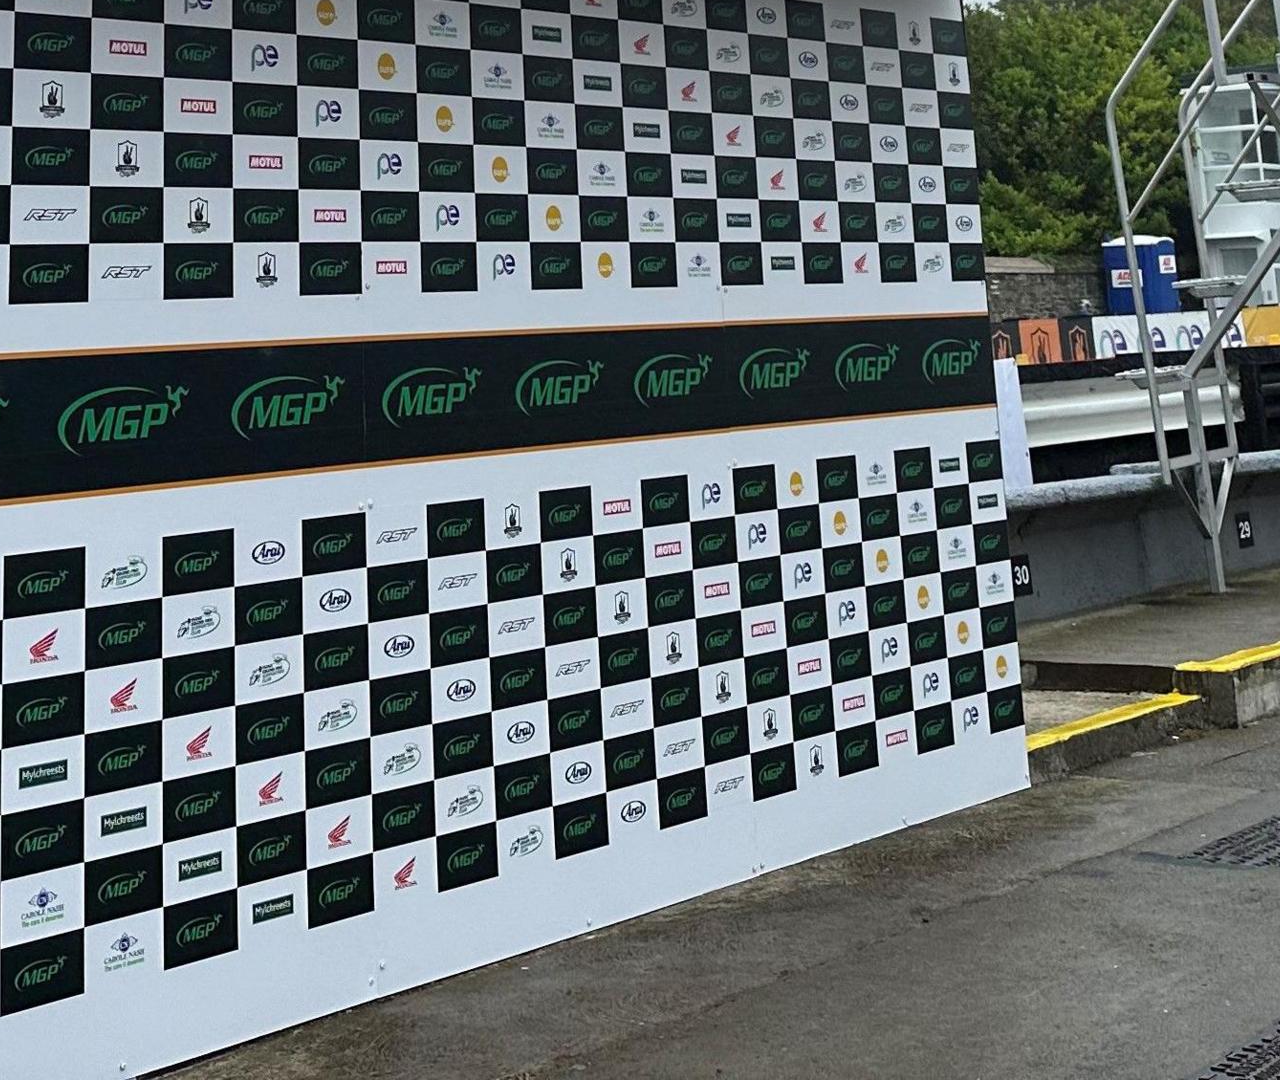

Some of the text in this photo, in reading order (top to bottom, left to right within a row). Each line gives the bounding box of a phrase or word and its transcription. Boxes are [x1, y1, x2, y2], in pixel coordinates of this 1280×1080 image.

[248, 1, 277, 15] MGP
[33, 37, 68, 52] MGP
[110, 41, 146, 54] MOTUL
[181, 47, 211, 62] MGP
[312, 57, 339, 71] MGP
[109, 97, 141, 112] MGP
[181, 100, 215, 112] MOTUL
[248, 104, 278, 118] MGP
[31, 151, 66, 166] MGP
[181, 155, 212, 169] MGP
[313, 159, 341, 172] MGP
[23, 207, 77, 221] RST
[108, 210, 141, 224] MGP
[249, 211, 279, 224] MGP
[29, 269, 65, 283] MGP
[100, 264, 152, 279] RST
[181, 266, 212, 280] MGP
[315, 264, 343, 277] MGP
[845, 356, 891, 383] MGP
[931, 351, 973, 377] MGP
[647, 368, 701, 398] MGP
[750, 362, 801, 390] MGP
[529, 374, 592, 407] MGP
[397, 383, 468, 417] MGP
[249, 391, 328, 429] MGP
[78, 403, 170, 443] MGP
[603, 500, 629, 514] MOTUL
[376, 526, 418, 545] RST
[442, 522, 467, 538] MGP
[1239, 521, 1251, 539] 29
[256, 543, 281, 559] Arai
[318, 538, 347, 555] MGP
[654, 542, 680, 556] MOTUL
[180, 556, 212, 574] MGP
[1013, 564, 1029, 585] 30
[24, 576, 60, 595] MGP
[383, 585, 410, 602] MGP
[251, 605, 282, 623] MGP
[104, 627, 138, 646] MGP
[445, 630, 471, 647] MGP
[320, 651, 349, 670] MGP
[180, 675, 213, 695] MGP
[23, 702, 59, 723] MGP
[385, 696, 413, 714] MGP
[252, 722, 283, 741] MGP
[448, 739, 474, 757] MGP
[104, 751, 138, 772] MGP
[322, 766, 351, 786] MGP
[181, 797, 213, 818] MGP
[388, 809, 416, 828] MGP
[22, 831, 59, 854] MGP
[254, 841, 285, 862] MGP
[452, 849, 479, 869] MGP
[104, 877, 139, 900] MGP
[324, 883, 354, 904] MGP
[182, 920, 215, 943] MGP
[21, 962, 58, 987] MGP
